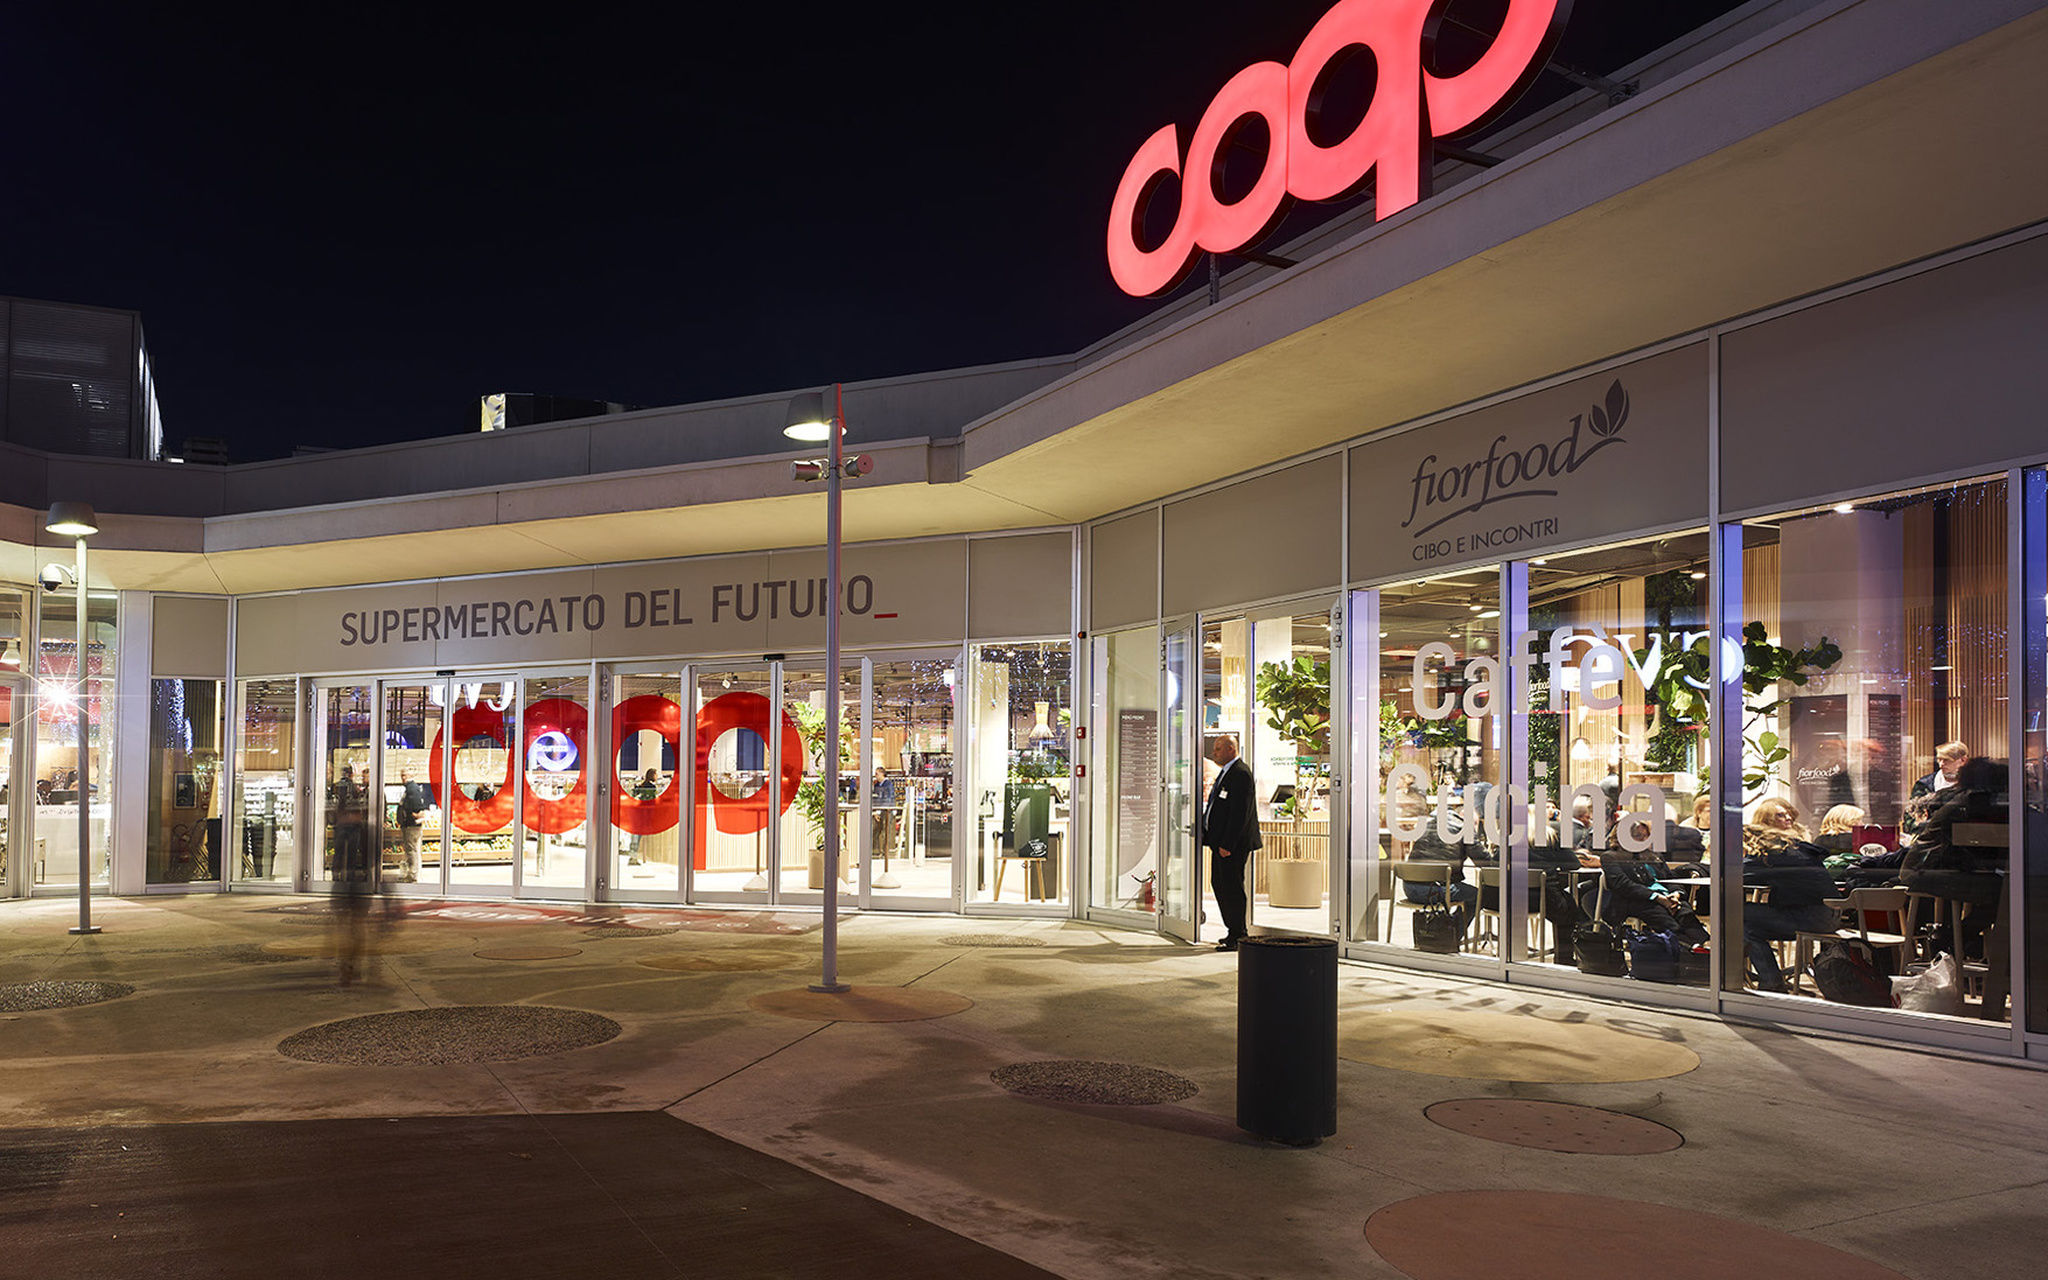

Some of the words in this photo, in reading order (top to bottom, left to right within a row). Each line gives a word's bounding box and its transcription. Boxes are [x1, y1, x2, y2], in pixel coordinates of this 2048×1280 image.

[1401, 414, 1584, 528] fiorfood
[1412, 539, 1451, 561] CIBO
[1456, 537, 1466, 553] E
[1470, 517, 1560, 550] INCONTRI
[340, 594, 605, 647] SUPERMERCATO
[624, 588, 694, 629] DEL
[1413, 622, 1625, 720] Caffè
[429, 691, 804, 871] coop
[1387, 762, 1667, 853] Cucina
